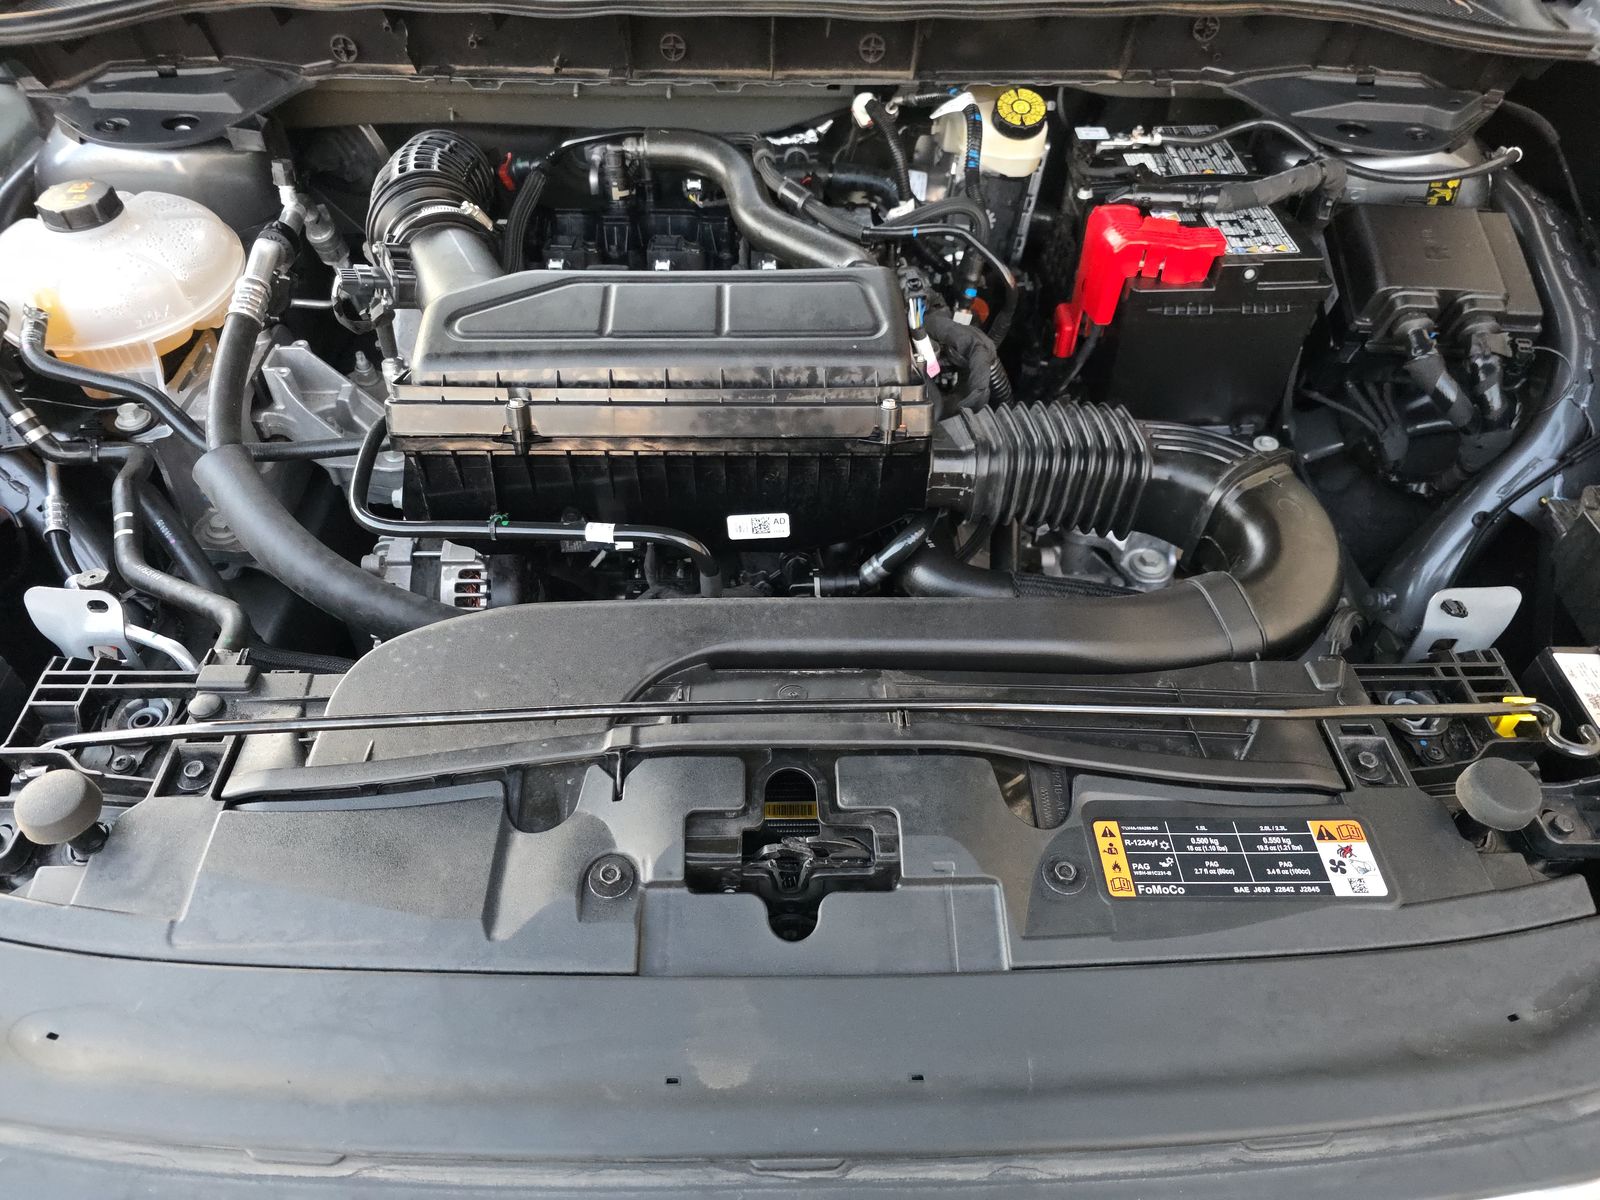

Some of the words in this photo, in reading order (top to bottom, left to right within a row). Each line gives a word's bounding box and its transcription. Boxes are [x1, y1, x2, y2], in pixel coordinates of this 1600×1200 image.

[773, 517, 786, 525] AD
[1124, 839, 1158, 848] R-1234yf
[1209, 837, 1219, 846] kg
[1282, 837, 1292, 846] kg
[1137, 884, 1186, 894] FoMoCo
